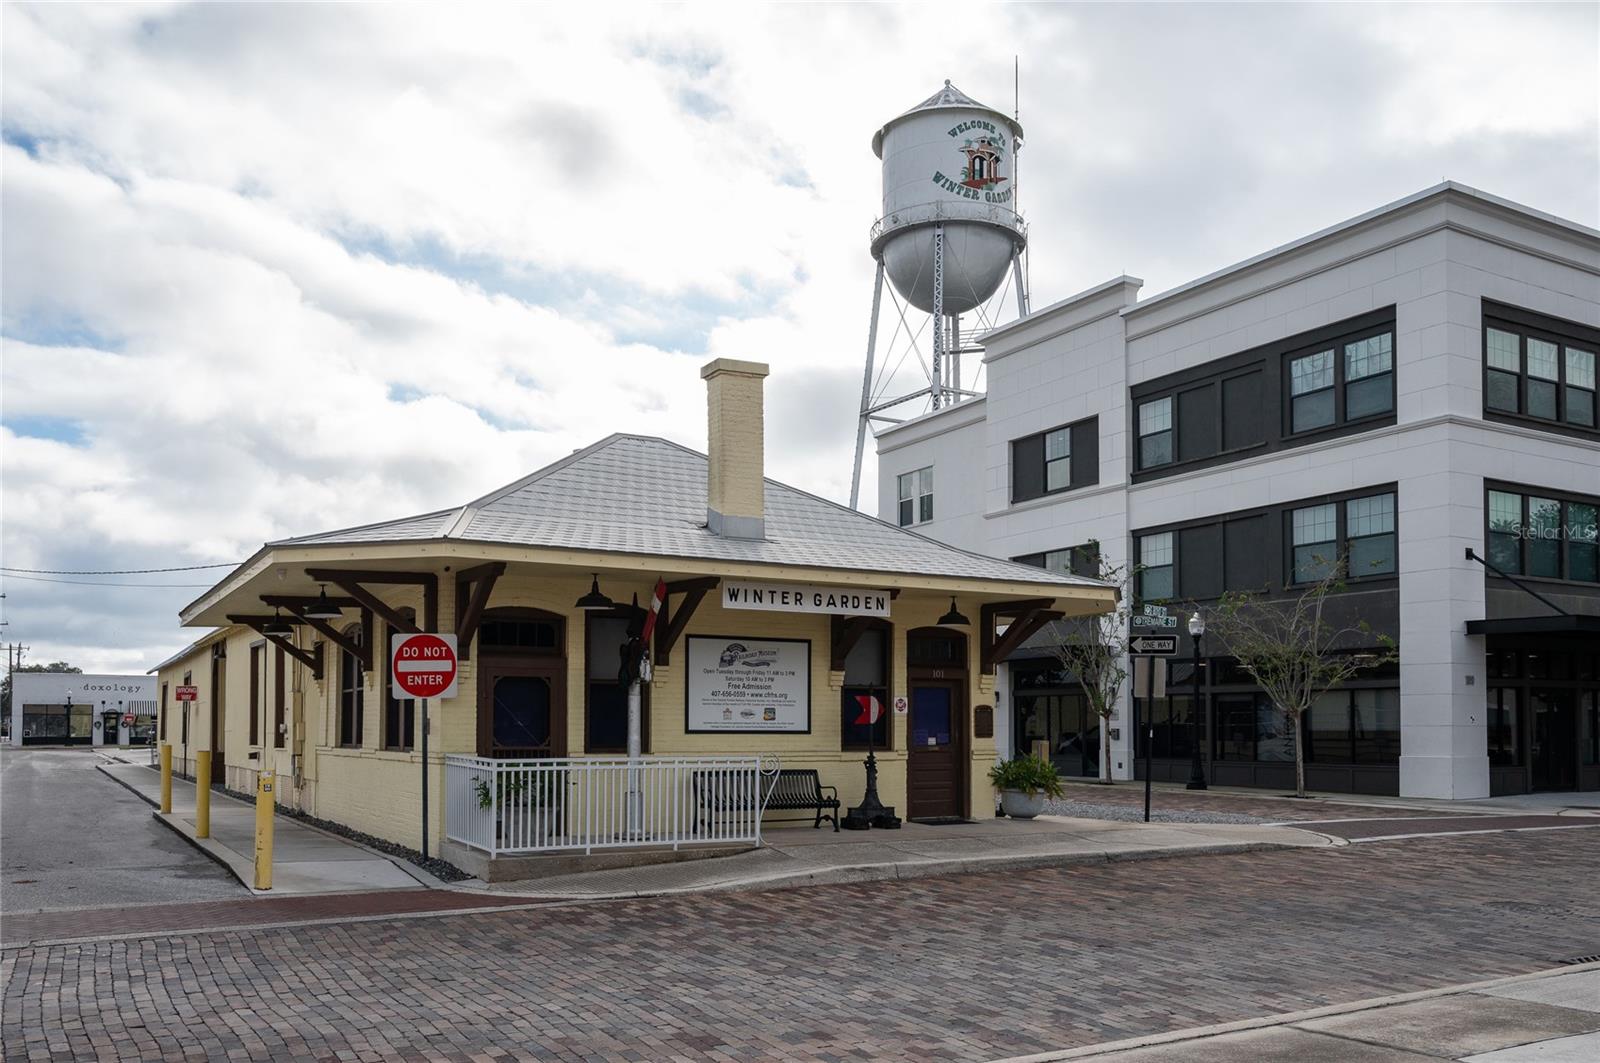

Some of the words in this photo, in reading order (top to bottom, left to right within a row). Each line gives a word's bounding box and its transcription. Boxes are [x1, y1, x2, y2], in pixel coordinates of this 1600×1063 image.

[948, 120, 996, 138] WELCOME
[932, 170, 980, 200] WINTER
[728, 587, 803, 606] WINTER
[813, 593, 885, 610] GARDEN
[1142, 641, 1155, 649] ONE
[1157, 641, 1171, 650] WAY
[403, 647, 419, 657] DO
[424, 646, 447, 657] NOT
[932, 670, 944, 678] 101
[407, 674, 443, 686] ENTER
[83, 684, 141, 693] doxology
[741, 682, 772, 690] Admission
